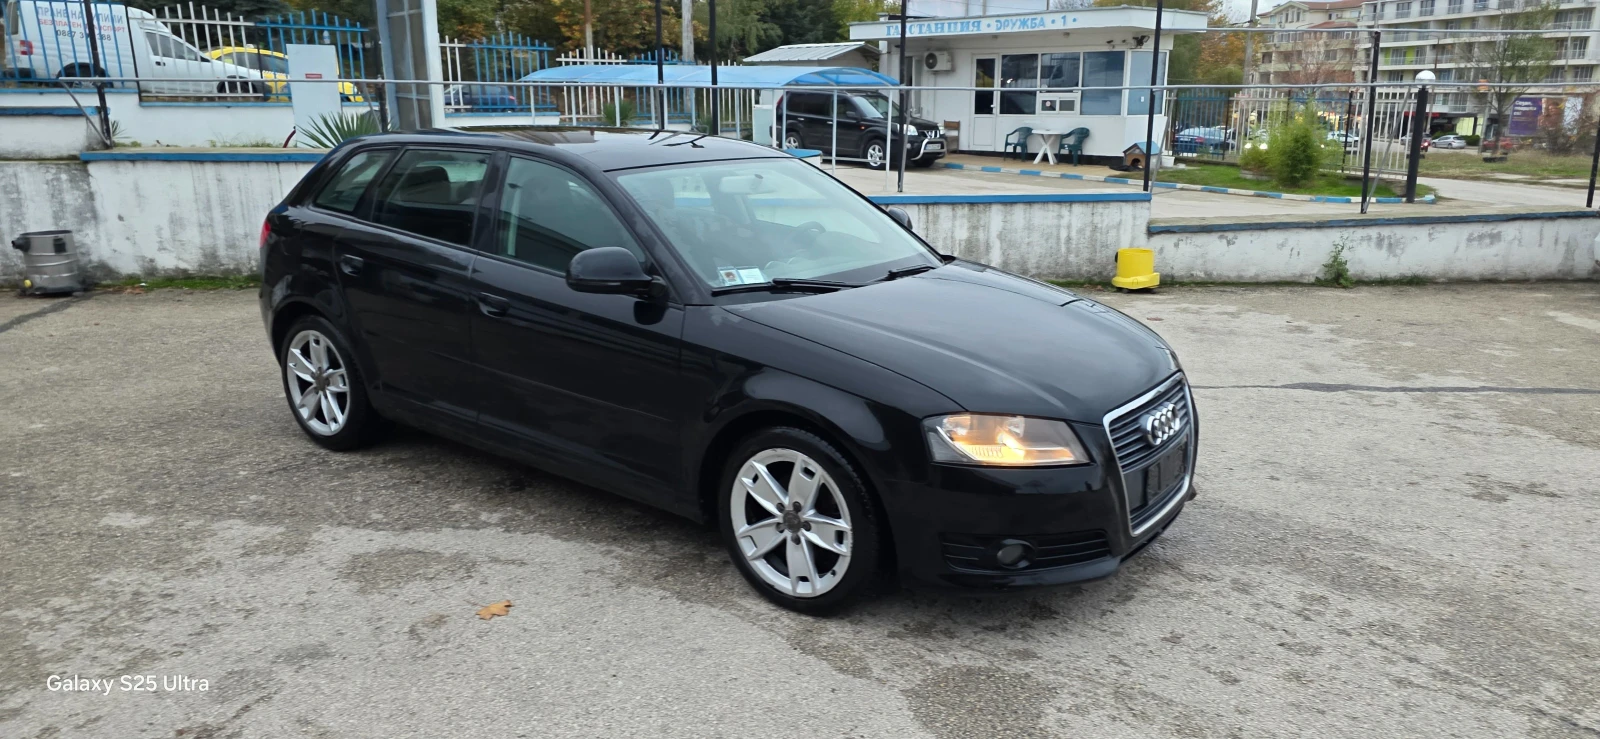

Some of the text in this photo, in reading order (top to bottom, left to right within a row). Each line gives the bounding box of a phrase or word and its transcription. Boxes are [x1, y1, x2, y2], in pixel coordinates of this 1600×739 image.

[39, 19, 82, 28] БЕЗПЛАЕН
[886, 15, 1067, 36] ГАСТАНЦИЯ ДРУЖБА 1
